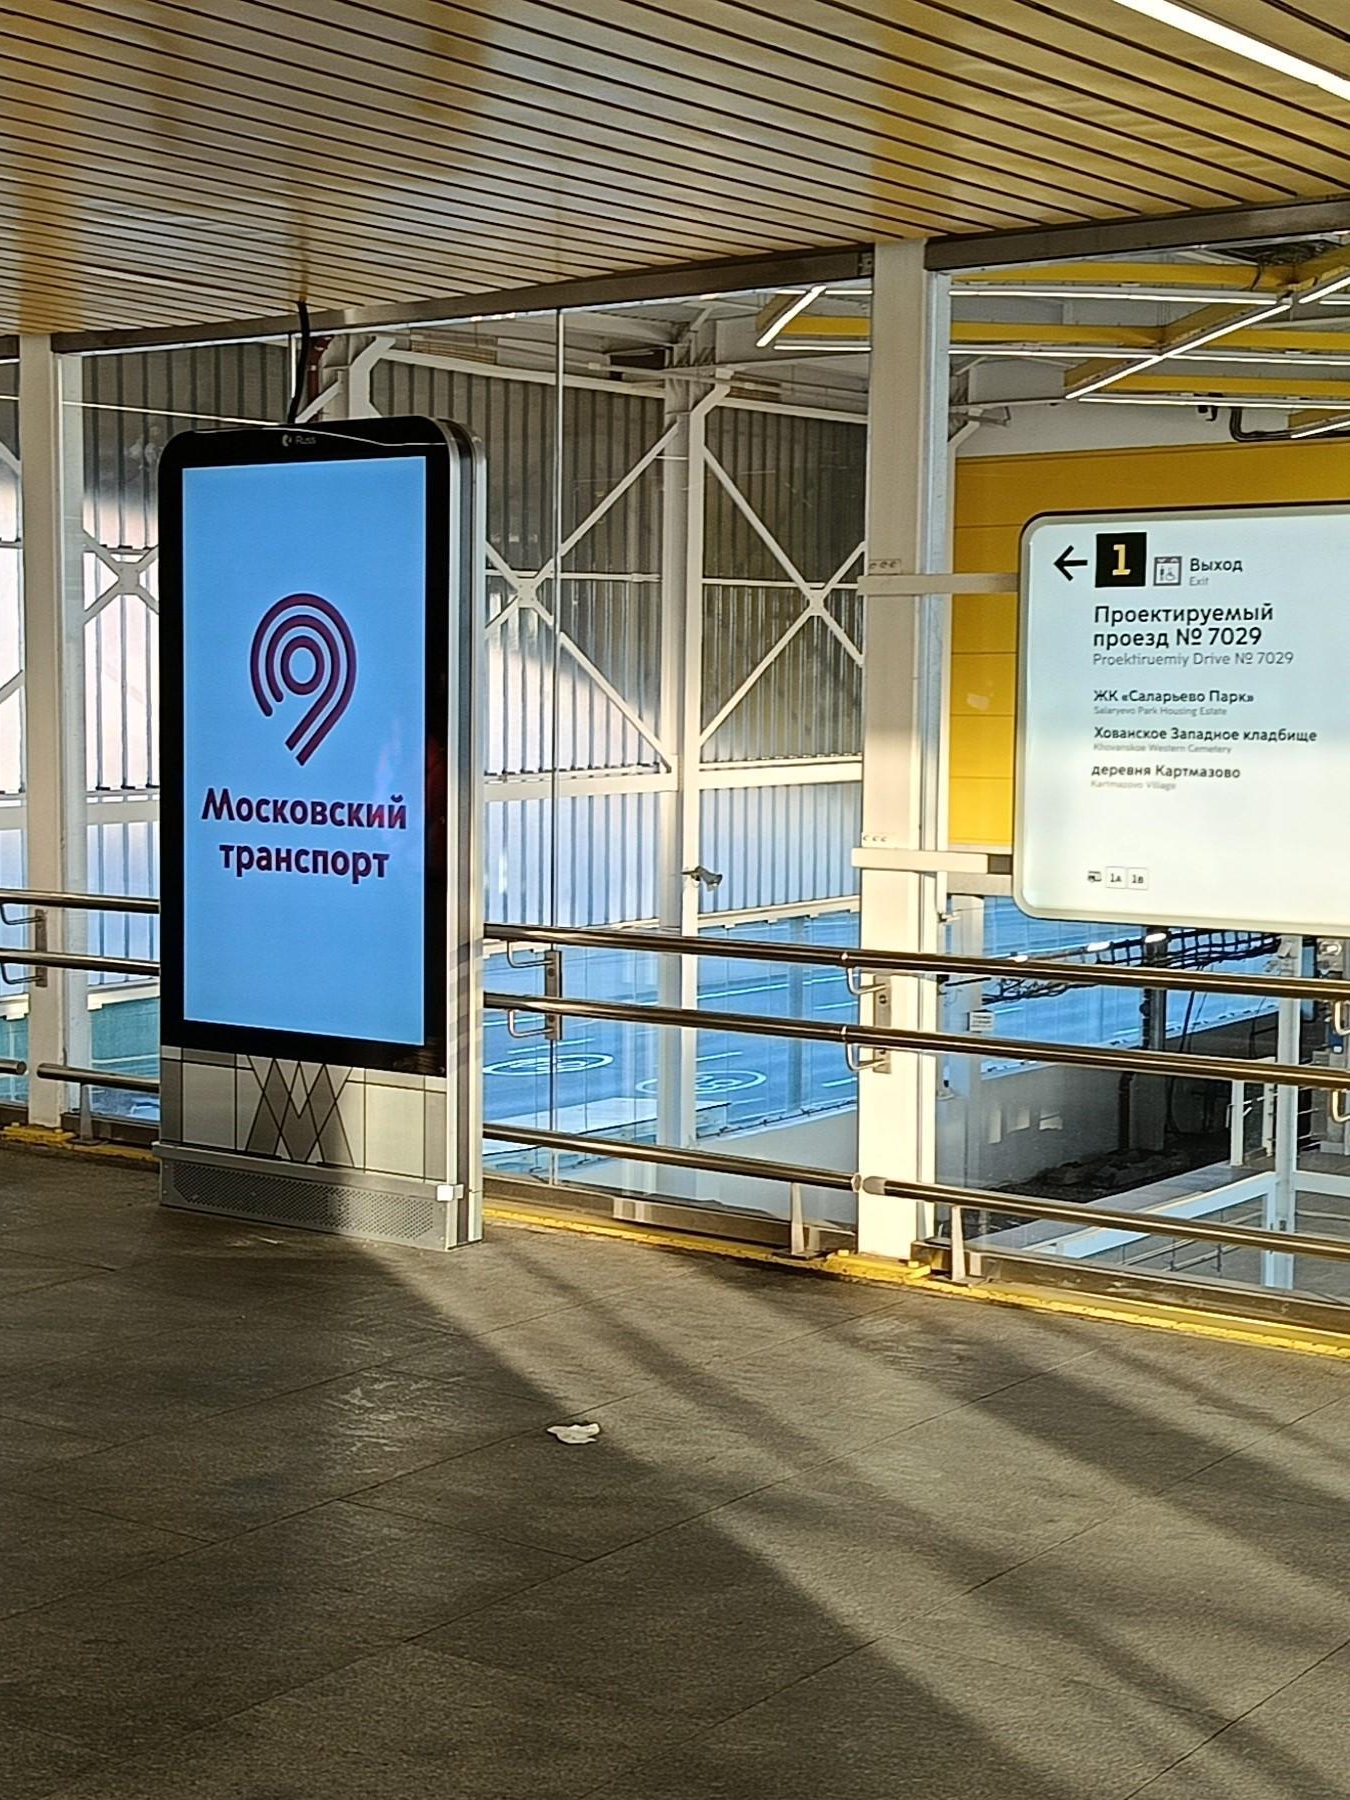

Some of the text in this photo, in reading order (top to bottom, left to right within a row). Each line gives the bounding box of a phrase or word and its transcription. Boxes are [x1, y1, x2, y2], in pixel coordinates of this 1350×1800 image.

[1112, 543, 1131, 576] 1
[1190, 557, 1243, 573] Выход
[1189, 576, 1209, 586] Exit
[1094, 603, 1274, 627] Проектируемый
[1093, 627, 1262, 650] проезд № 7029
[1093, 652, 1189, 667] Proektiruemiy
[1193, 652, 1231, 664] Drive
[1257, 651, 1294, 664] 7029
[1094, 690, 1254, 704] ЖК «Саларьево Парк»
[1138, 706, 1157, 715] Park
[1160, 706, 1197, 716] Housing
[1200, 707, 1227, 716] Estate
[1094, 727, 1317, 742] Хованское Западное кладбище
[1149, 743, 1185, 752] Western
[1188, 744, 1232, 754] Cemetery
[1091, 765, 1241, 779] деревня Картмазово
[202, 788, 407, 829] Московский
[219, 844, 390, 884] транспорт
